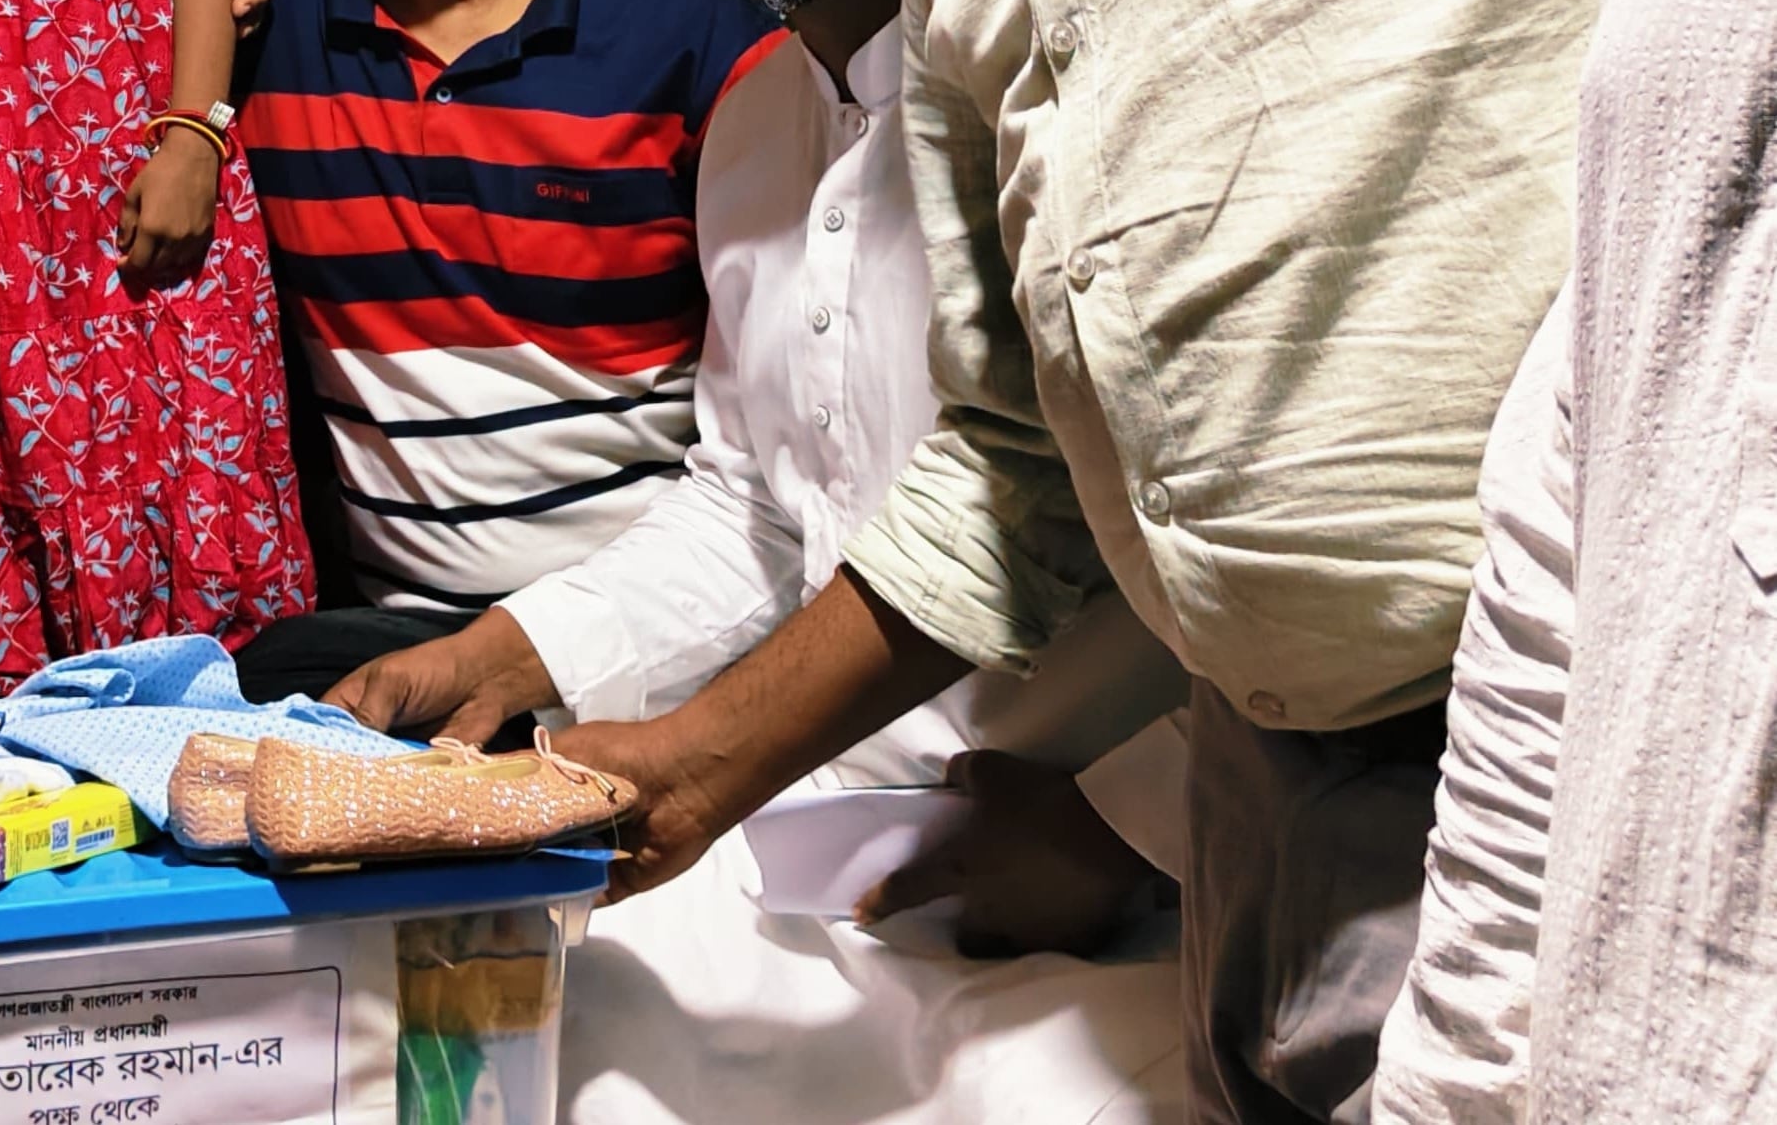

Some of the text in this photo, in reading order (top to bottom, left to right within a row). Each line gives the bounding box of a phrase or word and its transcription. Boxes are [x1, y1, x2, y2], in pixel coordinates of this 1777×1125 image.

[80, 989, 143, 1012] বাংলাদেশ
[150, 985, 198, 1003] সরকার
[24, 1015, 169, 1051] মাননীয় প্রধানমন্ত্রী
[116, 1037, 284, 1081] রহমান-এর
[28, 1094, 160, 1125] পক্ষ থেকে
